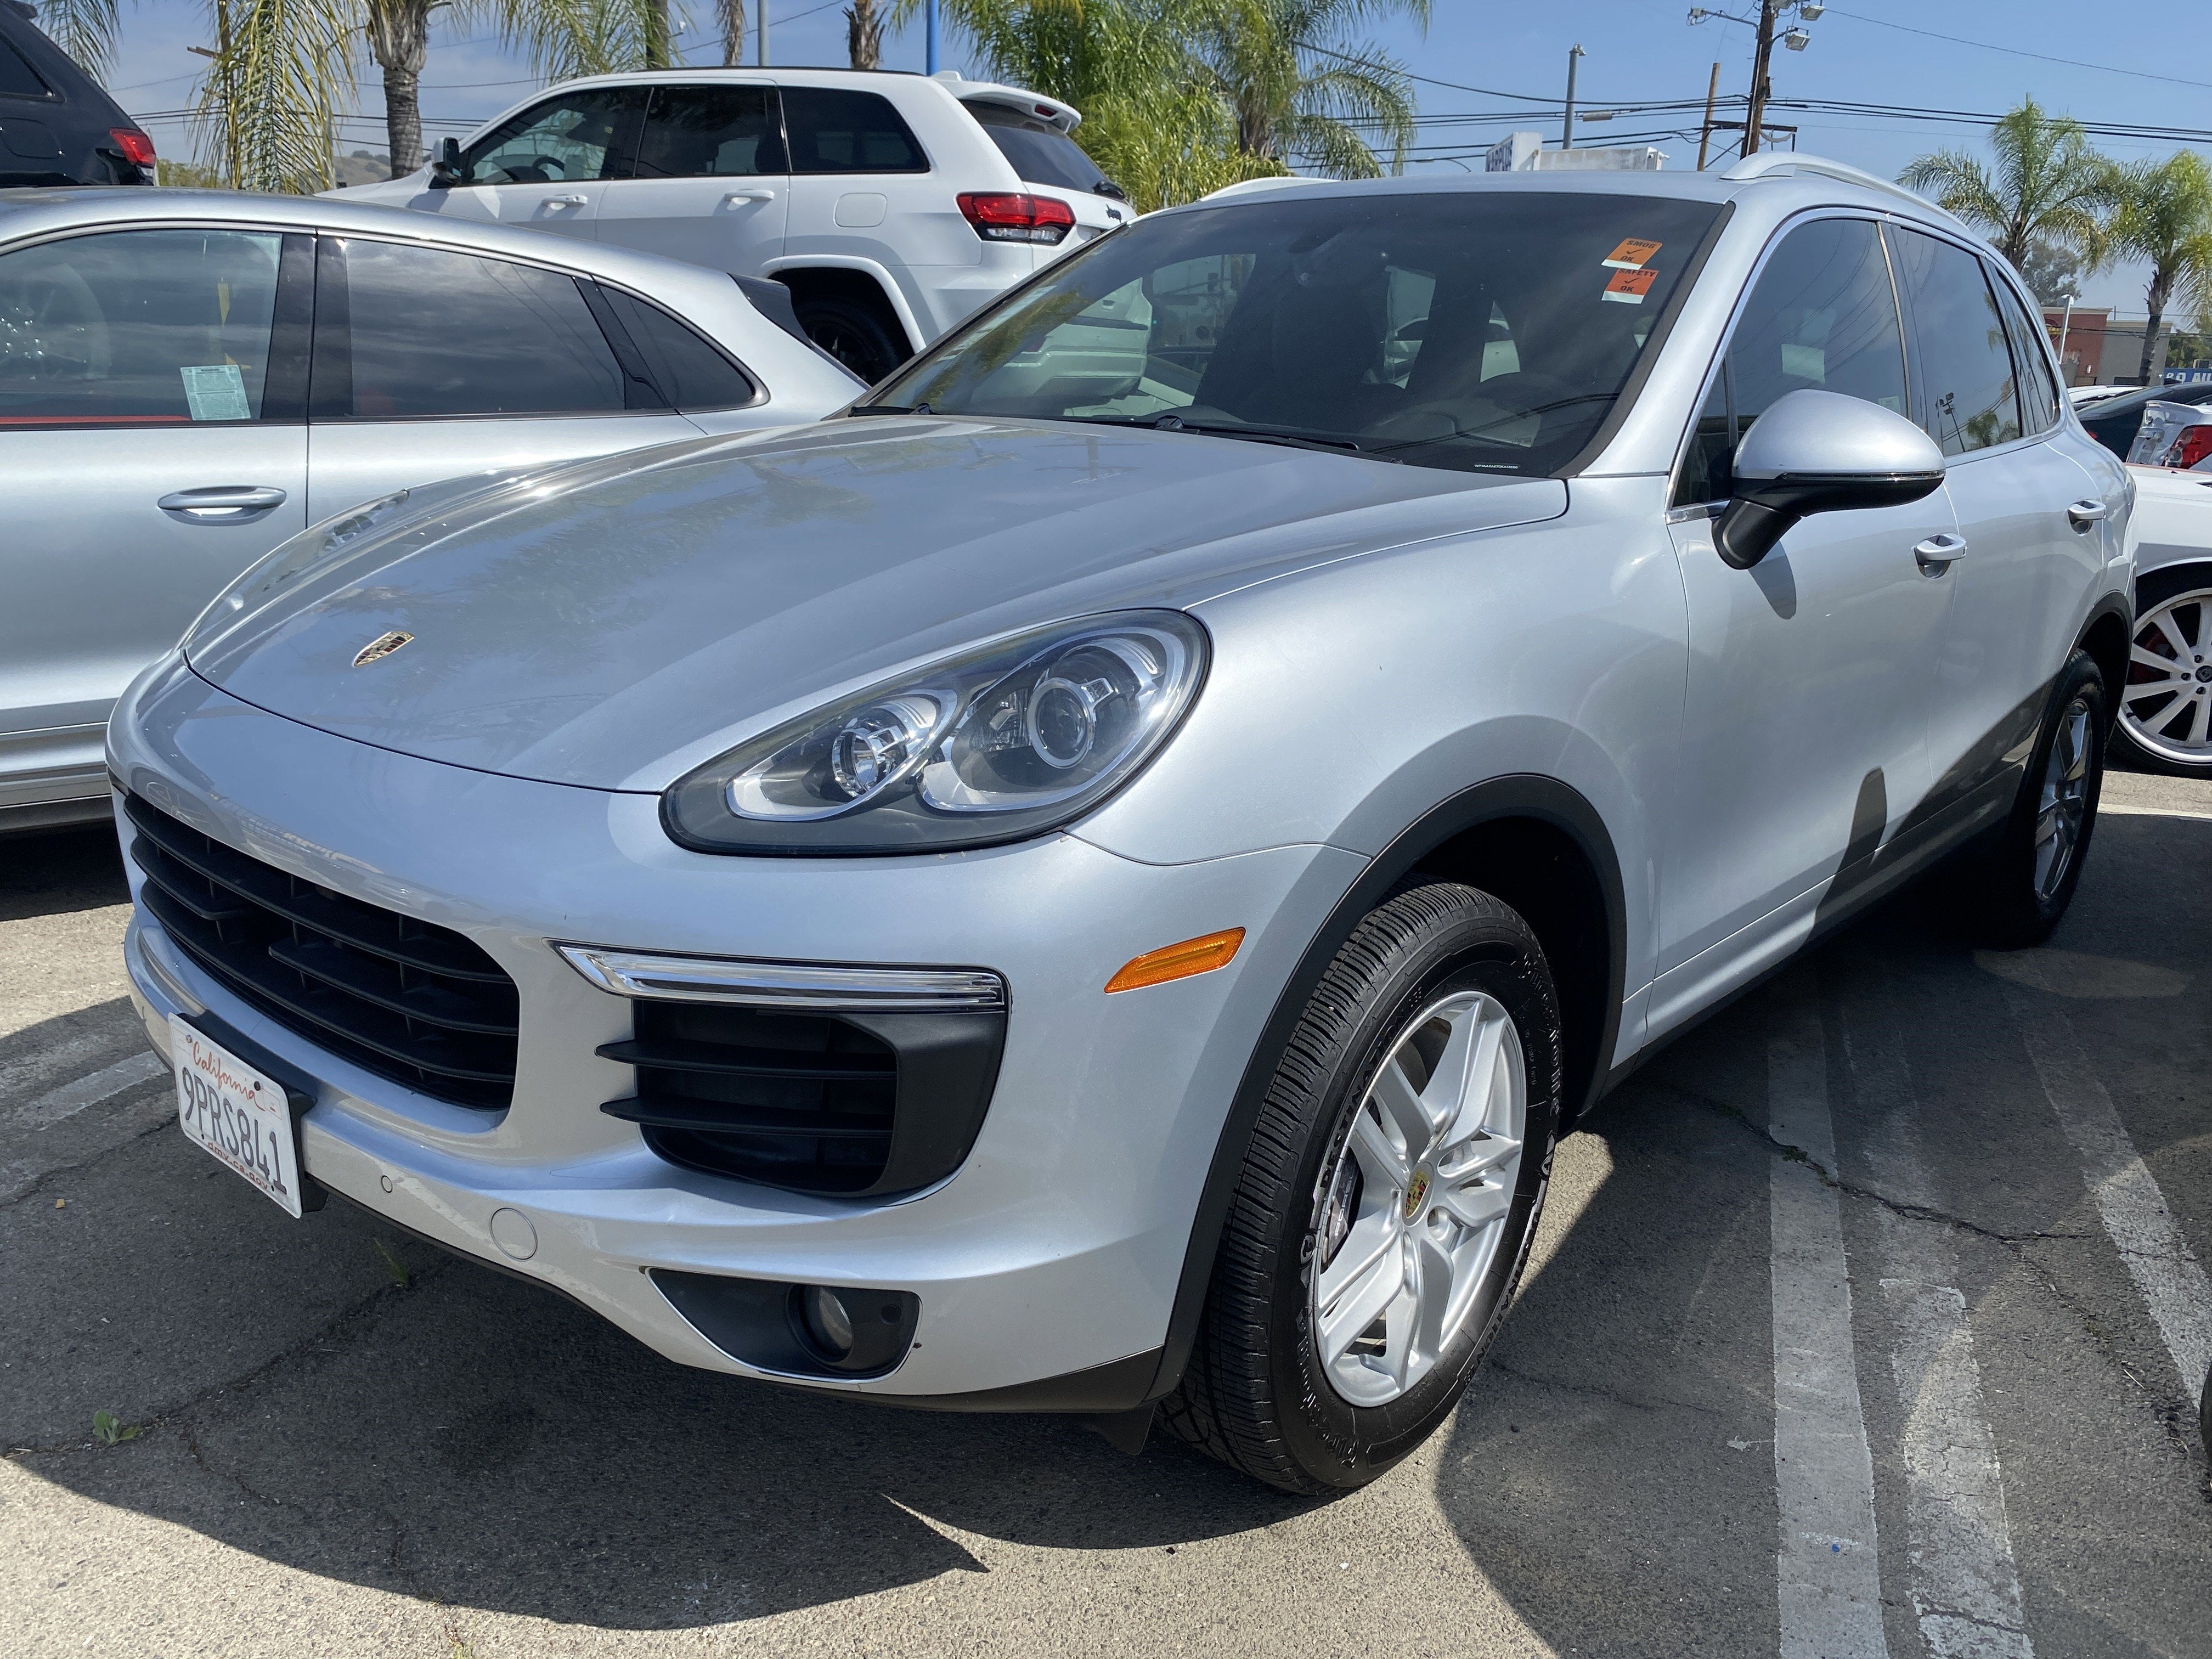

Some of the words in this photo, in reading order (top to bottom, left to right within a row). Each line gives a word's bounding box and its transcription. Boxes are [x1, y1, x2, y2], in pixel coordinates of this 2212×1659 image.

[1627, 240, 1656, 249] SMOG
[1618, 268, 1656, 276] SAFETY
[193, 1041, 266, 1112] California
[182, 1066, 287, 1195] 9PRS841
[207, 1142, 268, 1190] dmv.ca.gov
